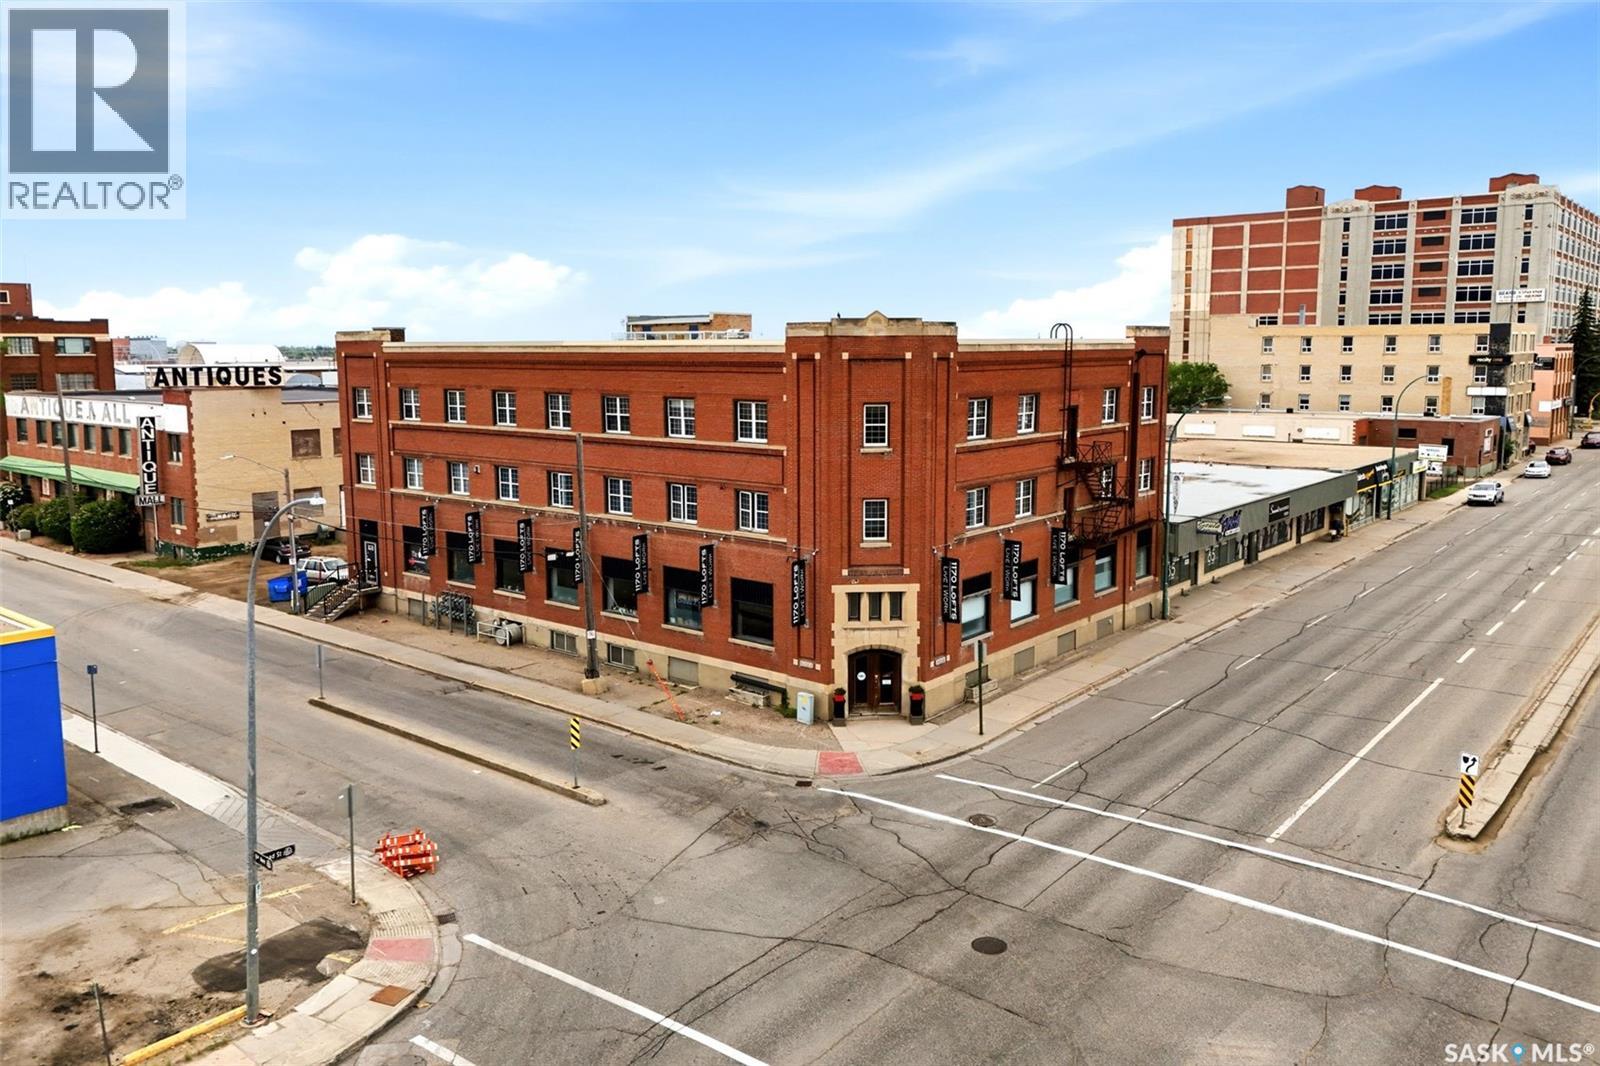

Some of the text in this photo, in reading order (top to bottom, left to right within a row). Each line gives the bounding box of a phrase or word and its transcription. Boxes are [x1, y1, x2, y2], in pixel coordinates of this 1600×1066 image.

[154, 366, 282, 387] ANTIQUES
[141, 417, 157, 495] ANTIQUE
[139, 496, 164, 506] MALL
[949, 562, 958, 621] 1170 LOFTS
[1011, 544, 1020, 598] 1170 LOFTS
